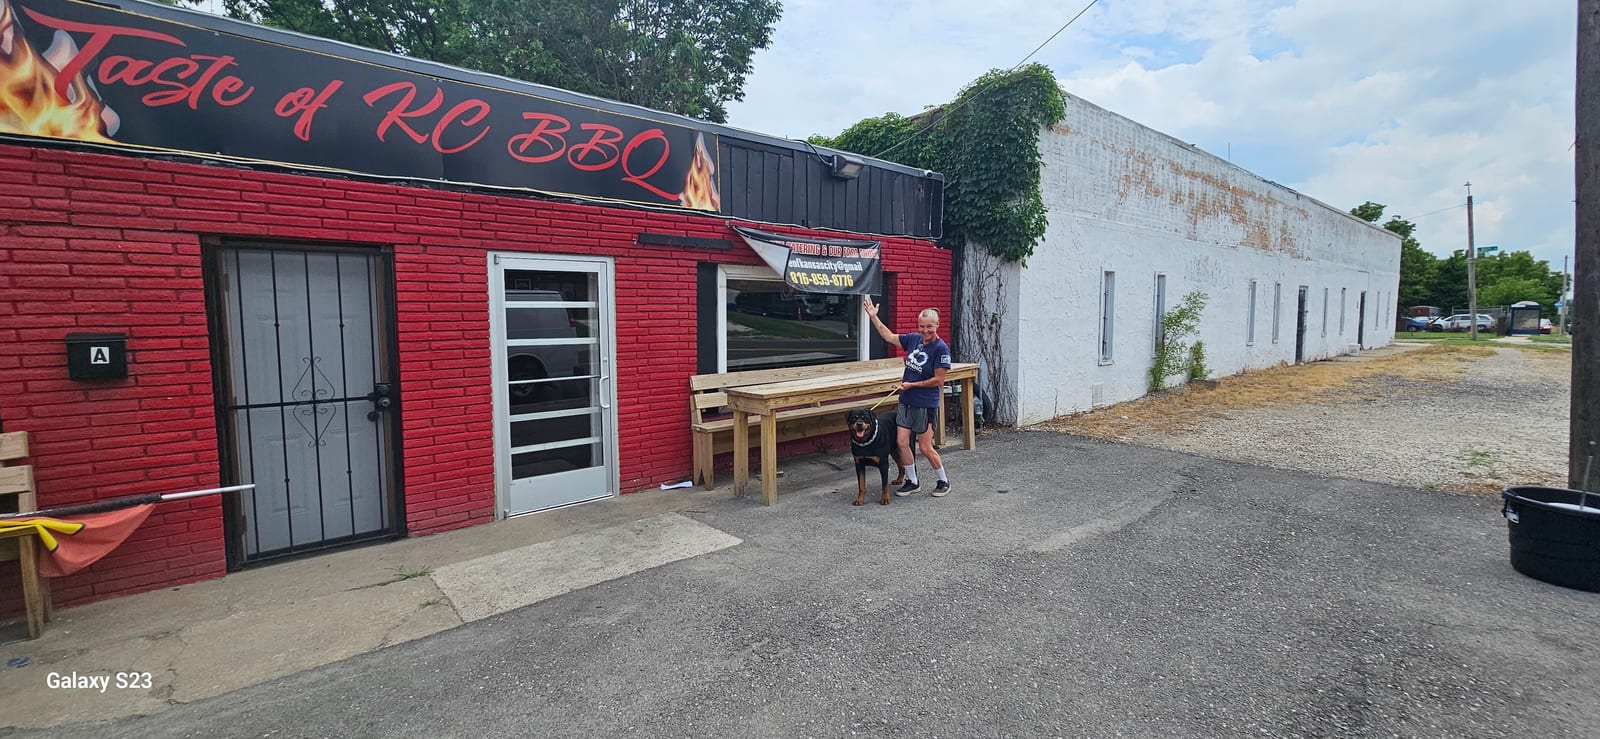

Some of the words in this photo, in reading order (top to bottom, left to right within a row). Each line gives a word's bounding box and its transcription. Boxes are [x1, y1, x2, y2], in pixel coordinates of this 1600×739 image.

[22, 5, 254, 110] Taste
[274, 79, 344, 142] of
[363, 81, 491, 154] KC
[507, 111, 680, 201] BBQ
[790, 272, 853, 286] 816-859-8776
[93, 347, 108, 363] A
